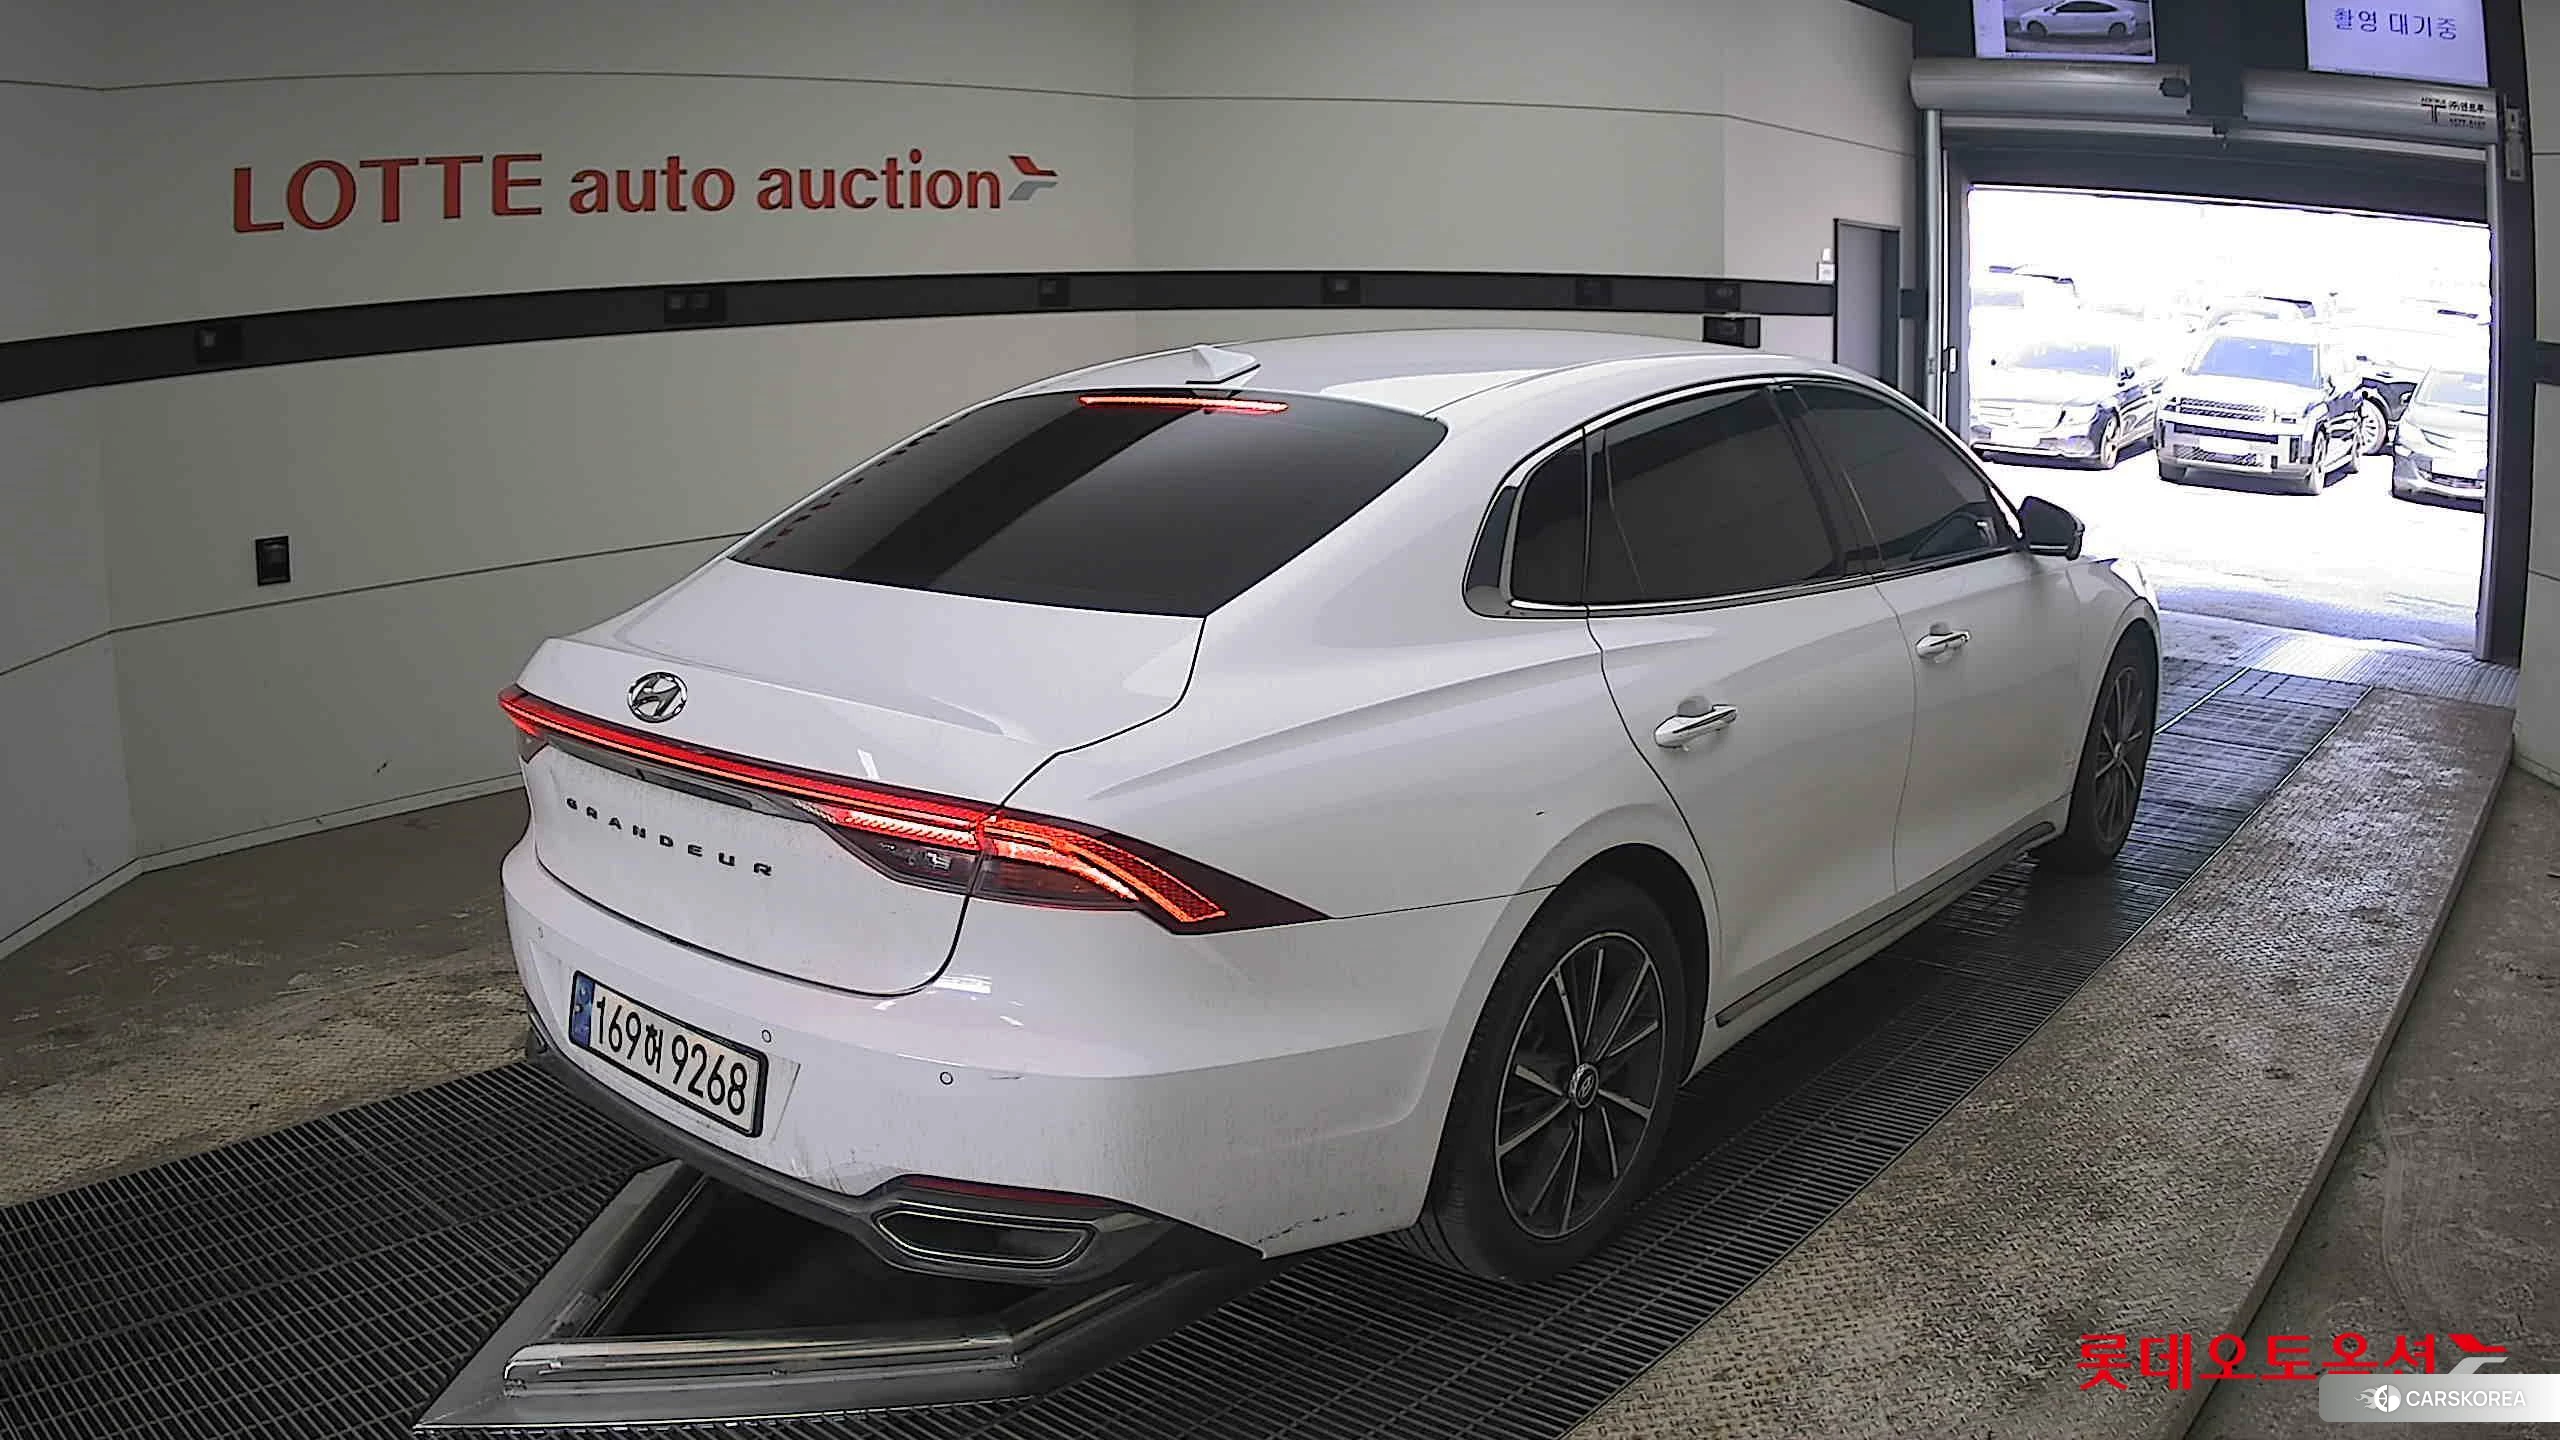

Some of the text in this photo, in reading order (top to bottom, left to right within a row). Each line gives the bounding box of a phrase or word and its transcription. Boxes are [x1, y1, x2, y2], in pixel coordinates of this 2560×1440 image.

[2334, 7, 2458, 41] 촬영 대기중
[234, 149, 1002, 233] LOTTE auto auction
[566, 797, 773, 877] GRANDEUR
[596, 996, 748, 1116] 169허 9268
